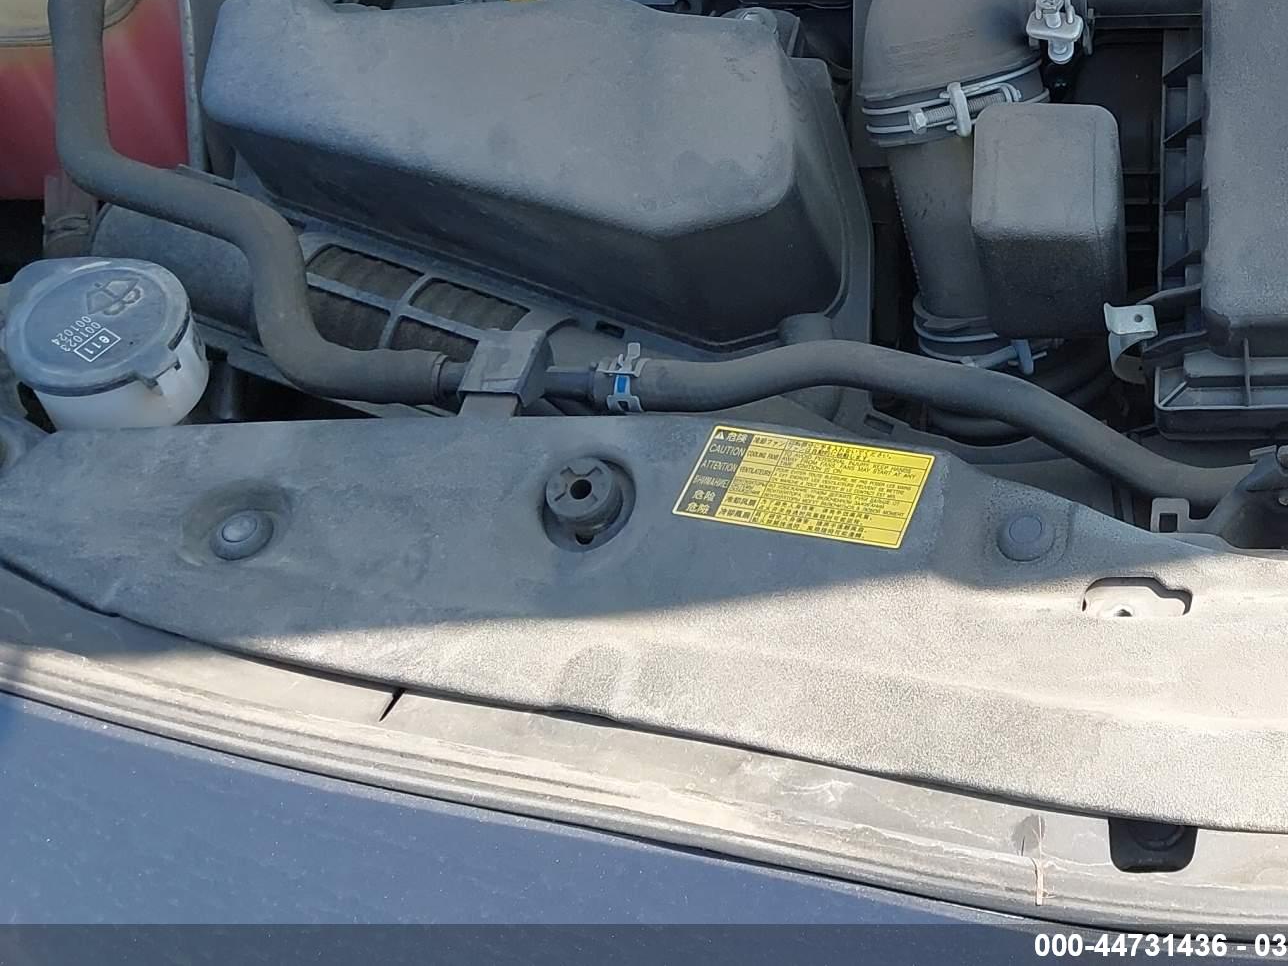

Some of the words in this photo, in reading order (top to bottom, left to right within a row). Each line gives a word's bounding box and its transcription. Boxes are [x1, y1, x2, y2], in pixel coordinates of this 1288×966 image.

[51, 315, 92, 346] 001024
[60, 321, 101, 352] 001023
[709, 444, 746, 457] CAUTION
[701, 459, 738, 473] ATTENTION
